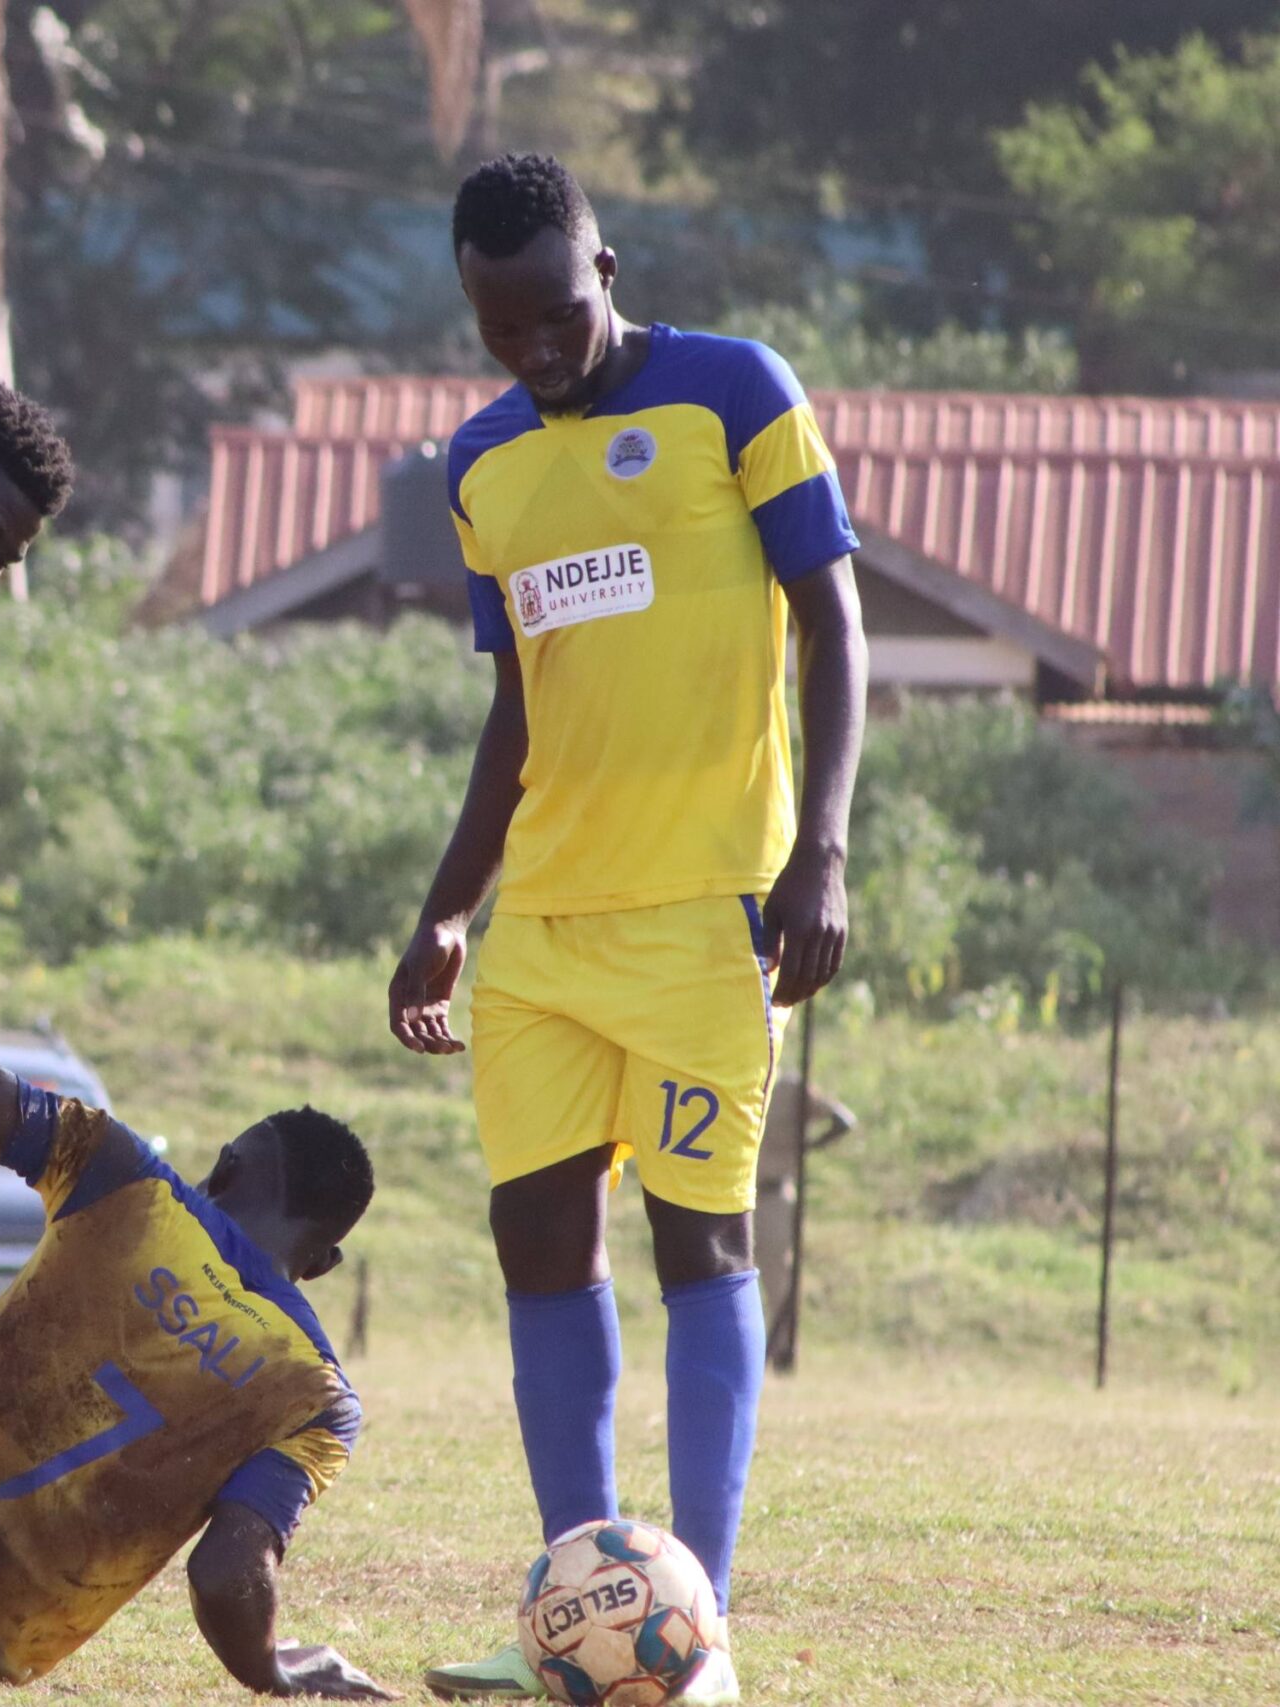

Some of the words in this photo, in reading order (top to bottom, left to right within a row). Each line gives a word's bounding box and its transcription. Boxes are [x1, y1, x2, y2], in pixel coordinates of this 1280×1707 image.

[545, 549, 645, 593] NDEJJE
[549, 581, 646, 611] UNIVERSITY
[659, 1080, 719, 1161] 12
[134, 1266, 266, 1389] SSALI
[542, 1577, 639, 1641] SELECT
